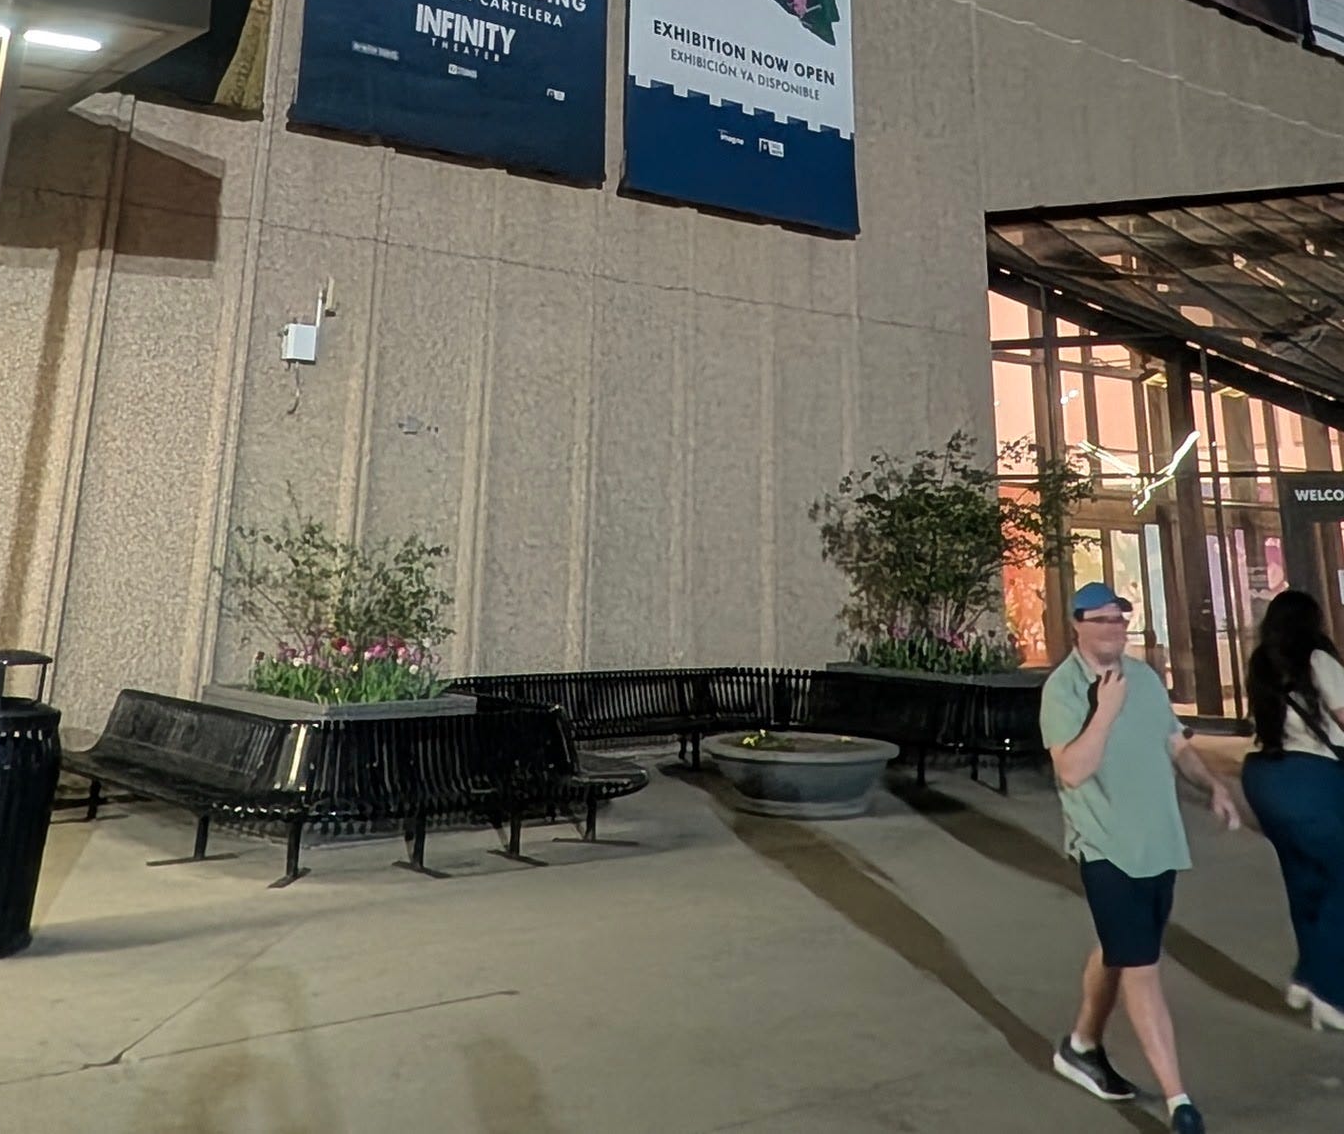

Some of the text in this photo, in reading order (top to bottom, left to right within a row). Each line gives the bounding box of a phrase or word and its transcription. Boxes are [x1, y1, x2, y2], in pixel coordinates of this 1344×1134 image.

[415, 2, 516, 56] INFINITY
[431, 37, 501, 63] THEATER
[653, 19, 836, 86] EXHIBITION NOW OPEN
[670, 48, 820, 101] EXHIBICIÓN YA DISPONIBLE
